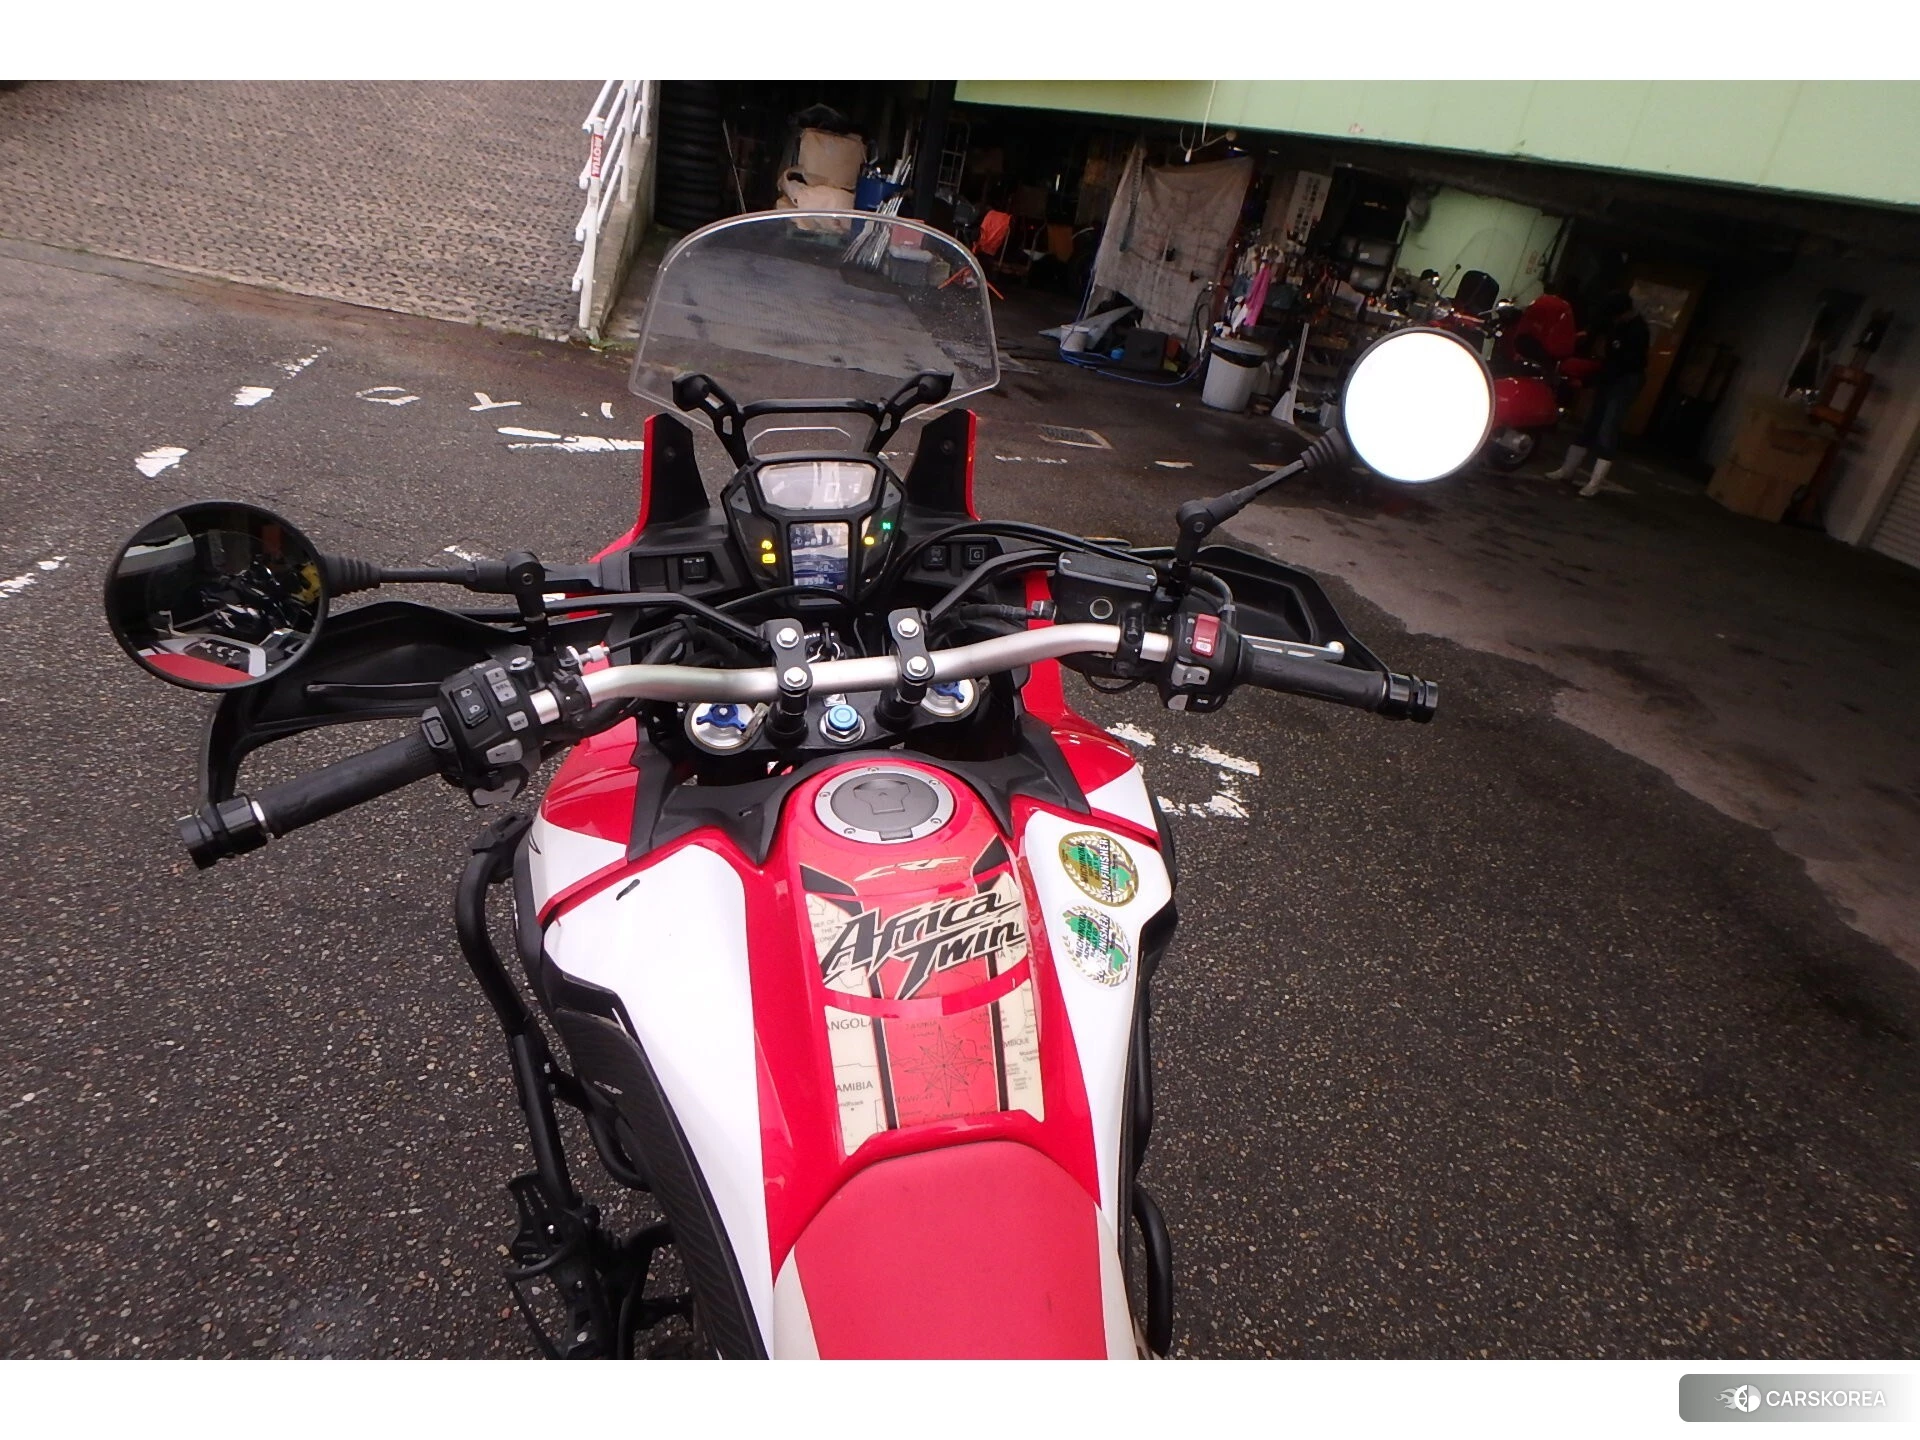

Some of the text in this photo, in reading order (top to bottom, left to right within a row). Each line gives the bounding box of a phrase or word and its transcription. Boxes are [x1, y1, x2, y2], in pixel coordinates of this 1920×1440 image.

[592, 136, 603, 175] MOTUL
[1100, 838, 1110, 879] FINISHER
[820, 891, 1021, 985] Africa
[892, 916, 1027, 1001] Twin
